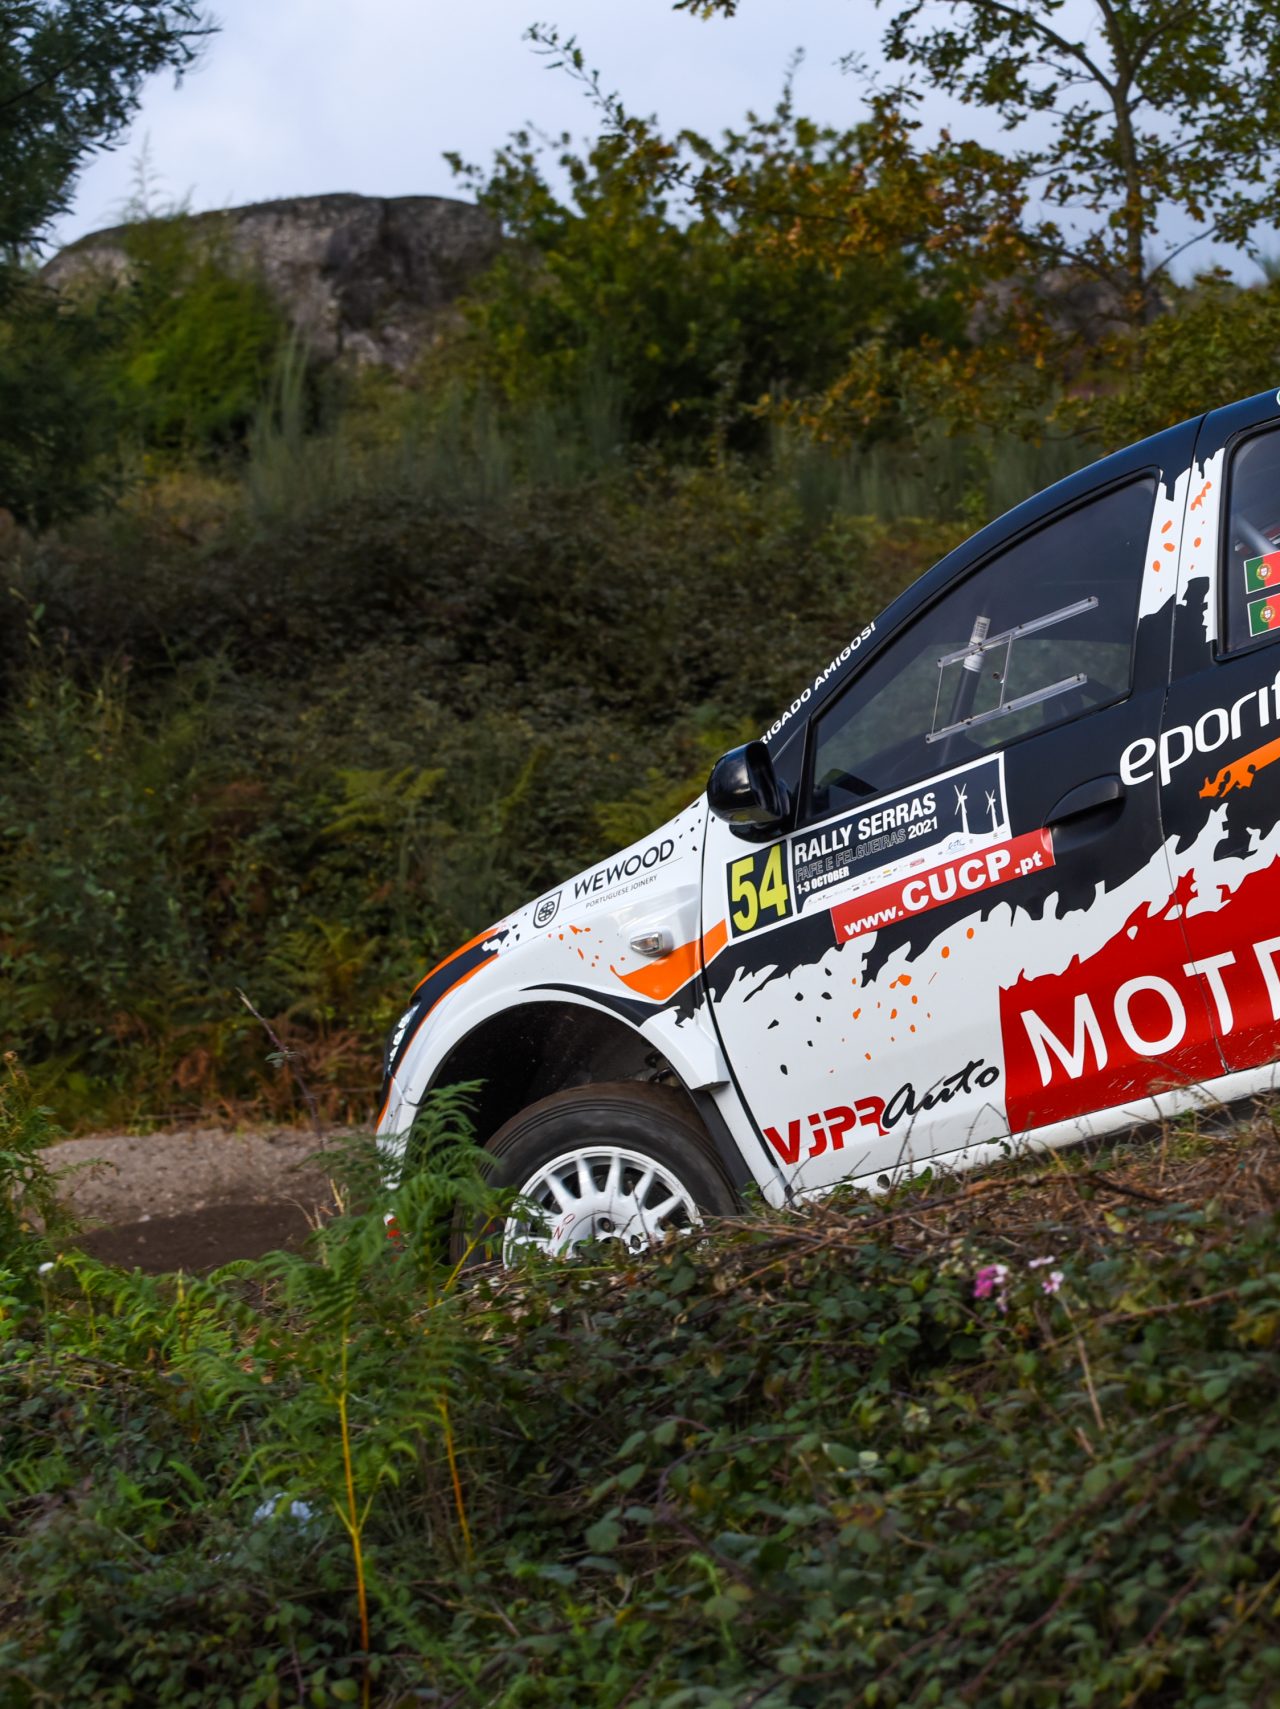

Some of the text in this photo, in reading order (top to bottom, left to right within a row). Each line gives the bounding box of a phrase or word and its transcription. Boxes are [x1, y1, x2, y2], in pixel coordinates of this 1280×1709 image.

[794, 792, 937, 866] RALLY SERRAS
[795, 816, 938, 882] FAFE E FELGUEIRAS 2021
[574, 839, 674, 899] WEWOOD
[585, 874, 657, 908] PORTUGUESE JOINERY
[731, 843, 789, 931] 54
[797, 880, 811, 894] 1-3
[811, 866, 850, 890] OCTOBER
[844, 850, 1043, 936] www.CUCP.pt
